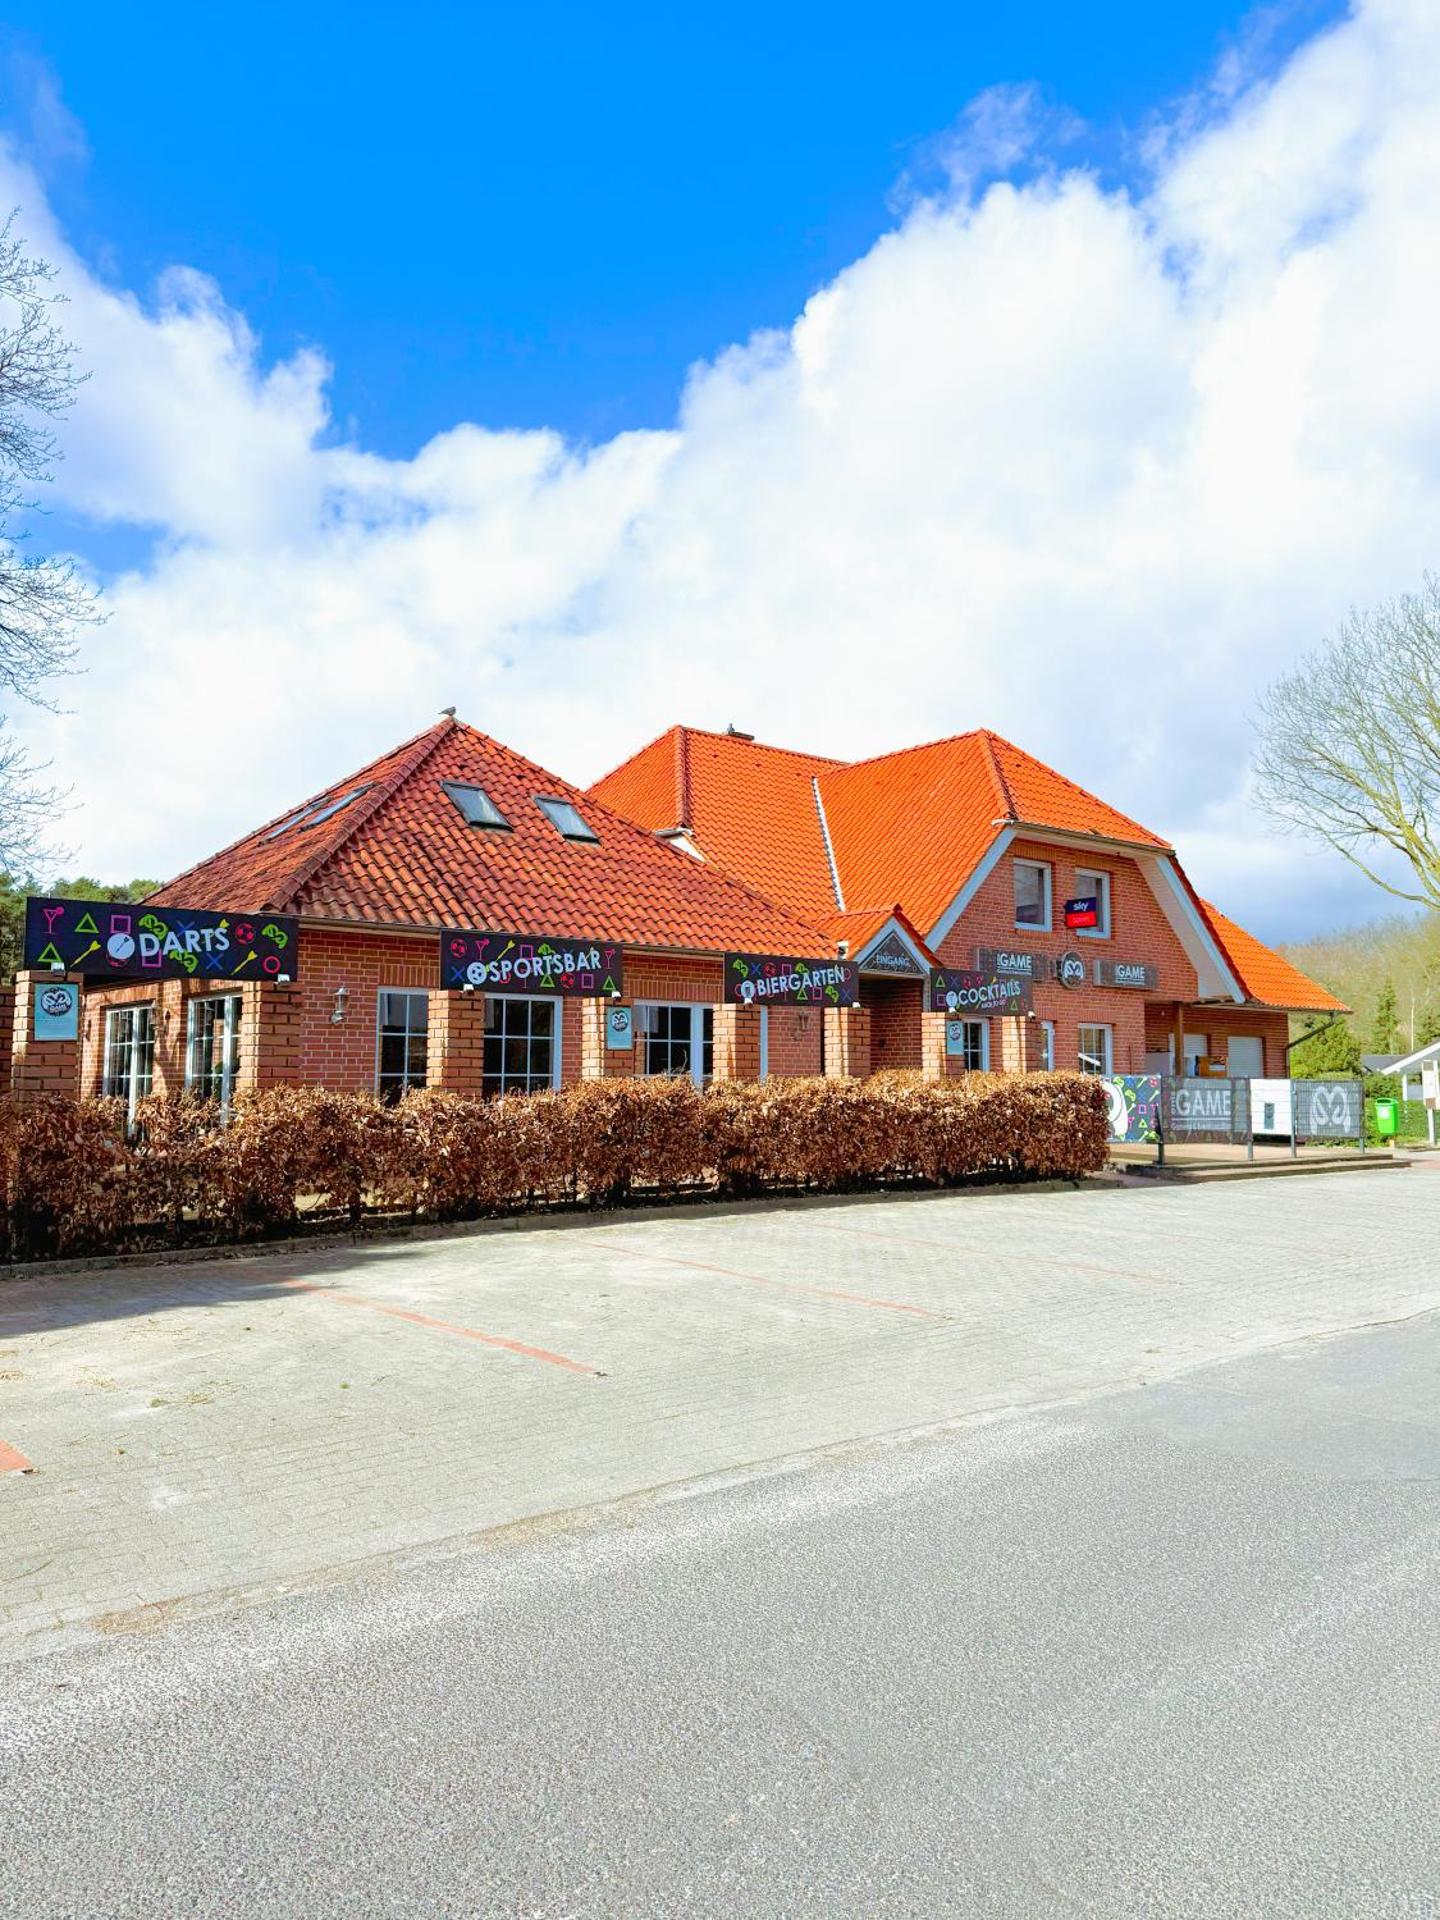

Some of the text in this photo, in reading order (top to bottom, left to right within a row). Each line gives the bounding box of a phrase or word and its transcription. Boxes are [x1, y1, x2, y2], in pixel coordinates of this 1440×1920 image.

[1073, 901, 1089, 912] sky
[138, 928, 230, 957] DARTS
[489, 950, 602, 982] SPORTSBAR
[876, 954, 910, 966] EINGANG
[1000, 953, 1032, 968] GAME
[1118, 964, 1145, 979] GAME
[757, 966, 845, 996] BIERGARTEN
[958, 981, 1021, 1006] COCKTAILS
[1176, 1089, 1231, 1116] GAME
